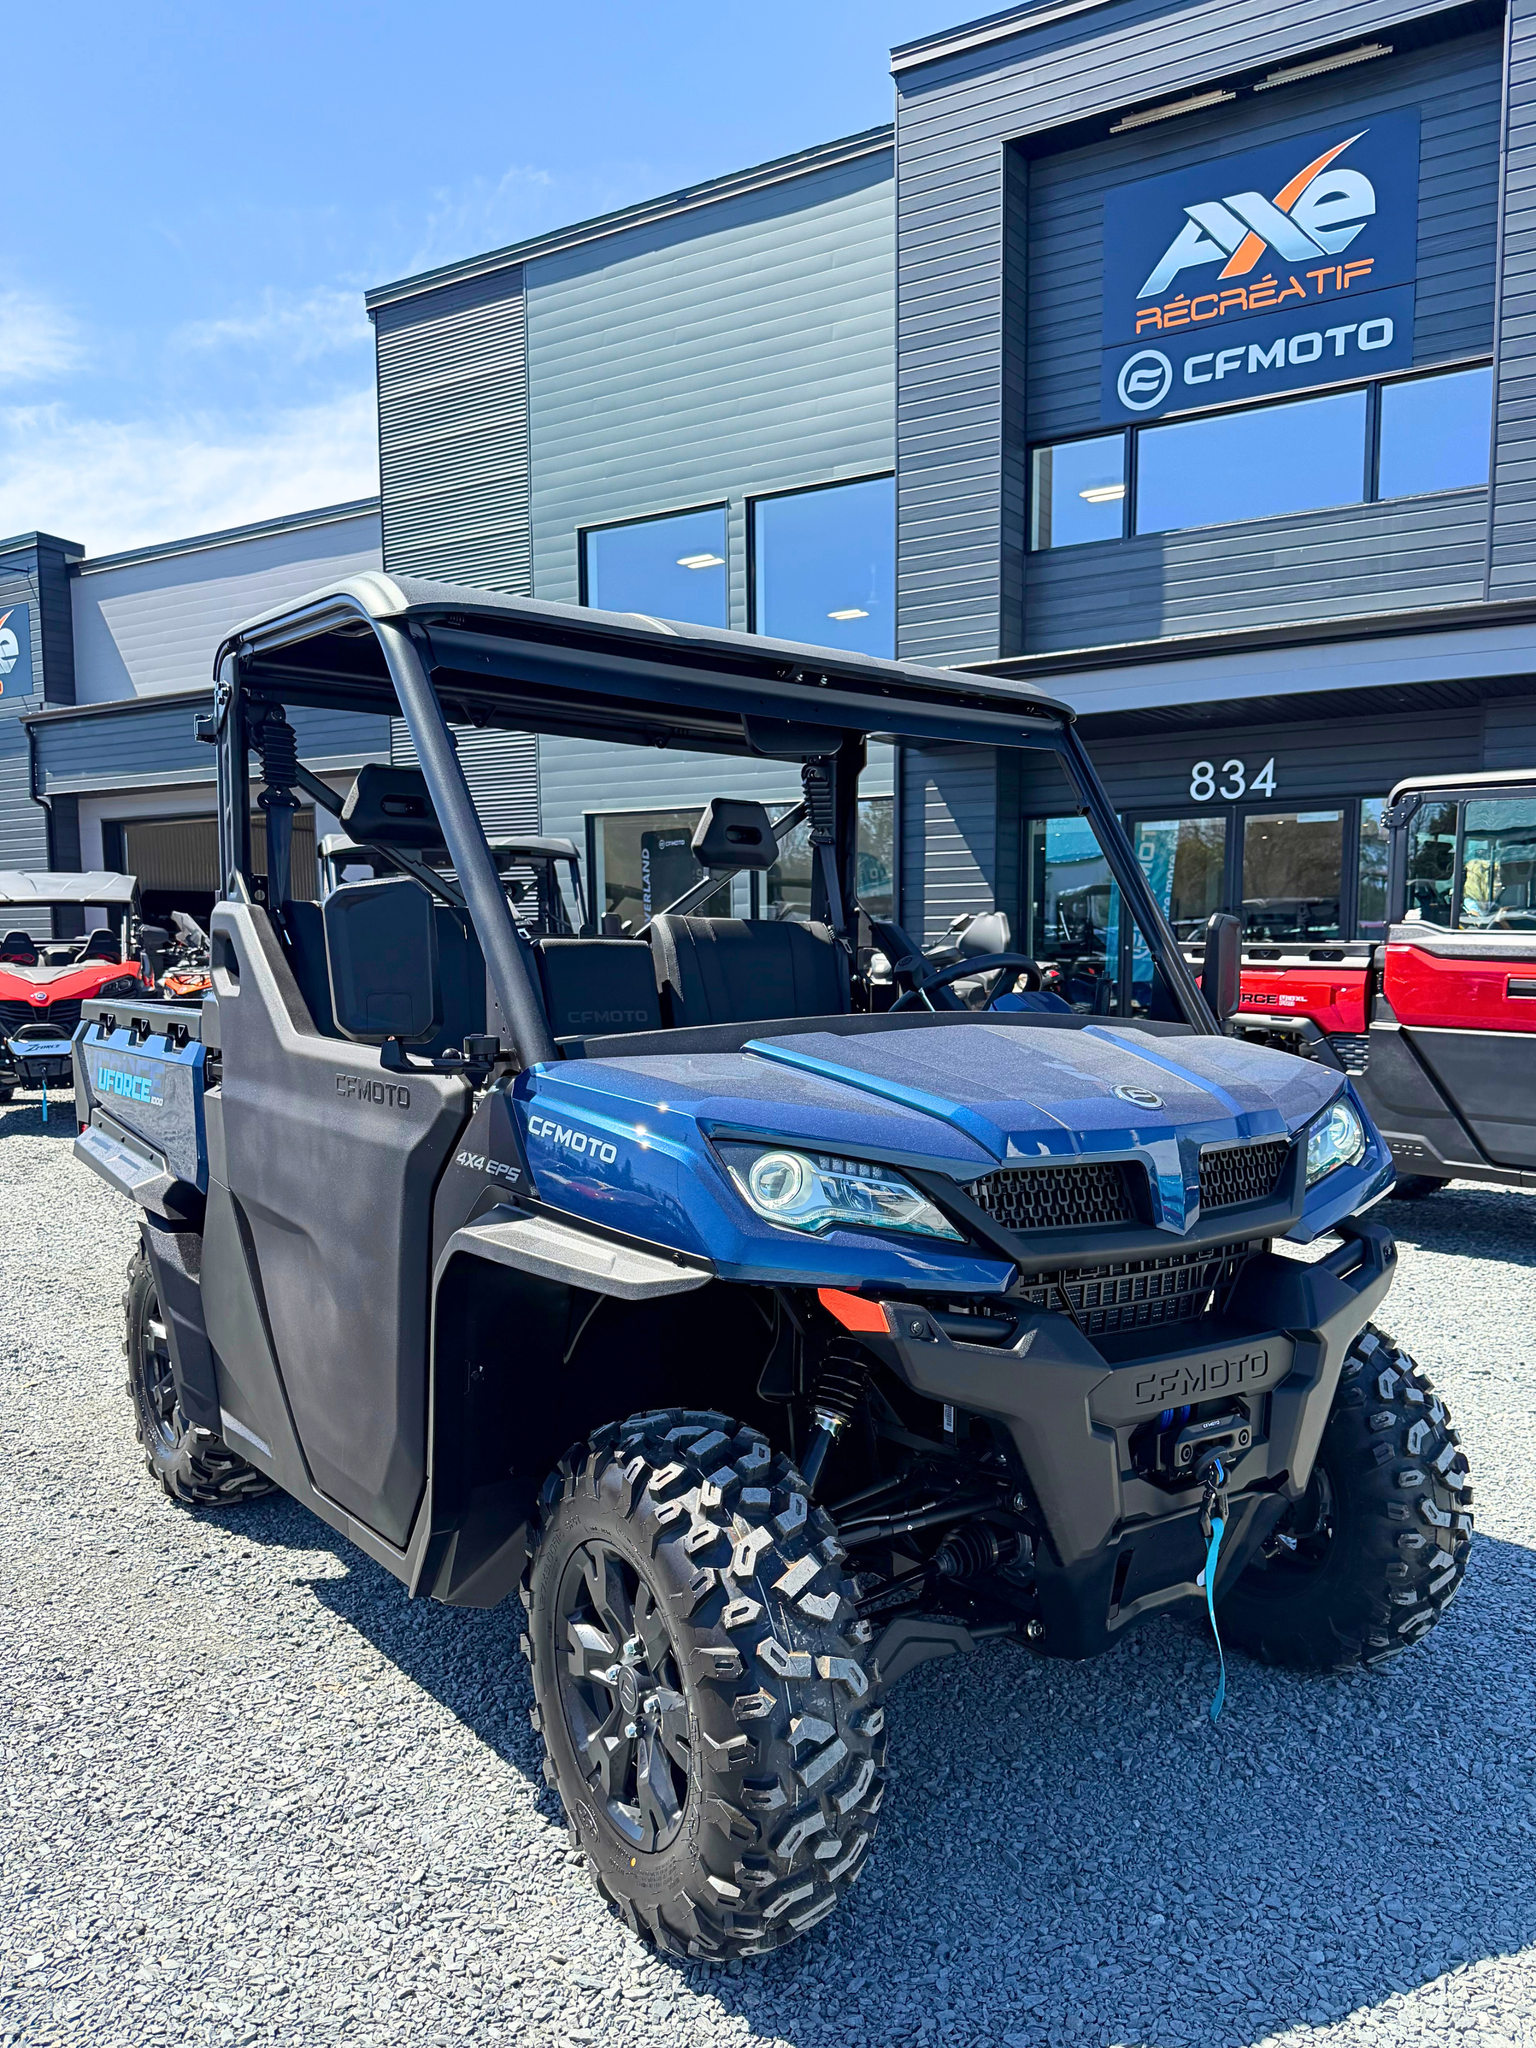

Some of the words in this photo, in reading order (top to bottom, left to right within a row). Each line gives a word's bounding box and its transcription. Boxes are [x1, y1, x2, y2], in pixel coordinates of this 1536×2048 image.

[1135, 257, 1375, 334] RÉCRÉATIF
[1183, 317, 1394, 385] CFMOTO
[1189, 757, 1277, 802] 834
[641, 848, 652, 923] VERLAND
[567, 1010, 649, 1024] CFMOTO
[98, 1066, 152, 1103] UFORCE
[151, 1096, 163, 1106] 1000
[335, 1072, 411, 1110] CFMOTO
[528, 1115, 618, 1164] CFMOTO
[455, 1151, 487, 1171] 4X4
[486, 1161, 522, 1184] EPS
[1133, 1350, 1269, 1405] CFMOTO
